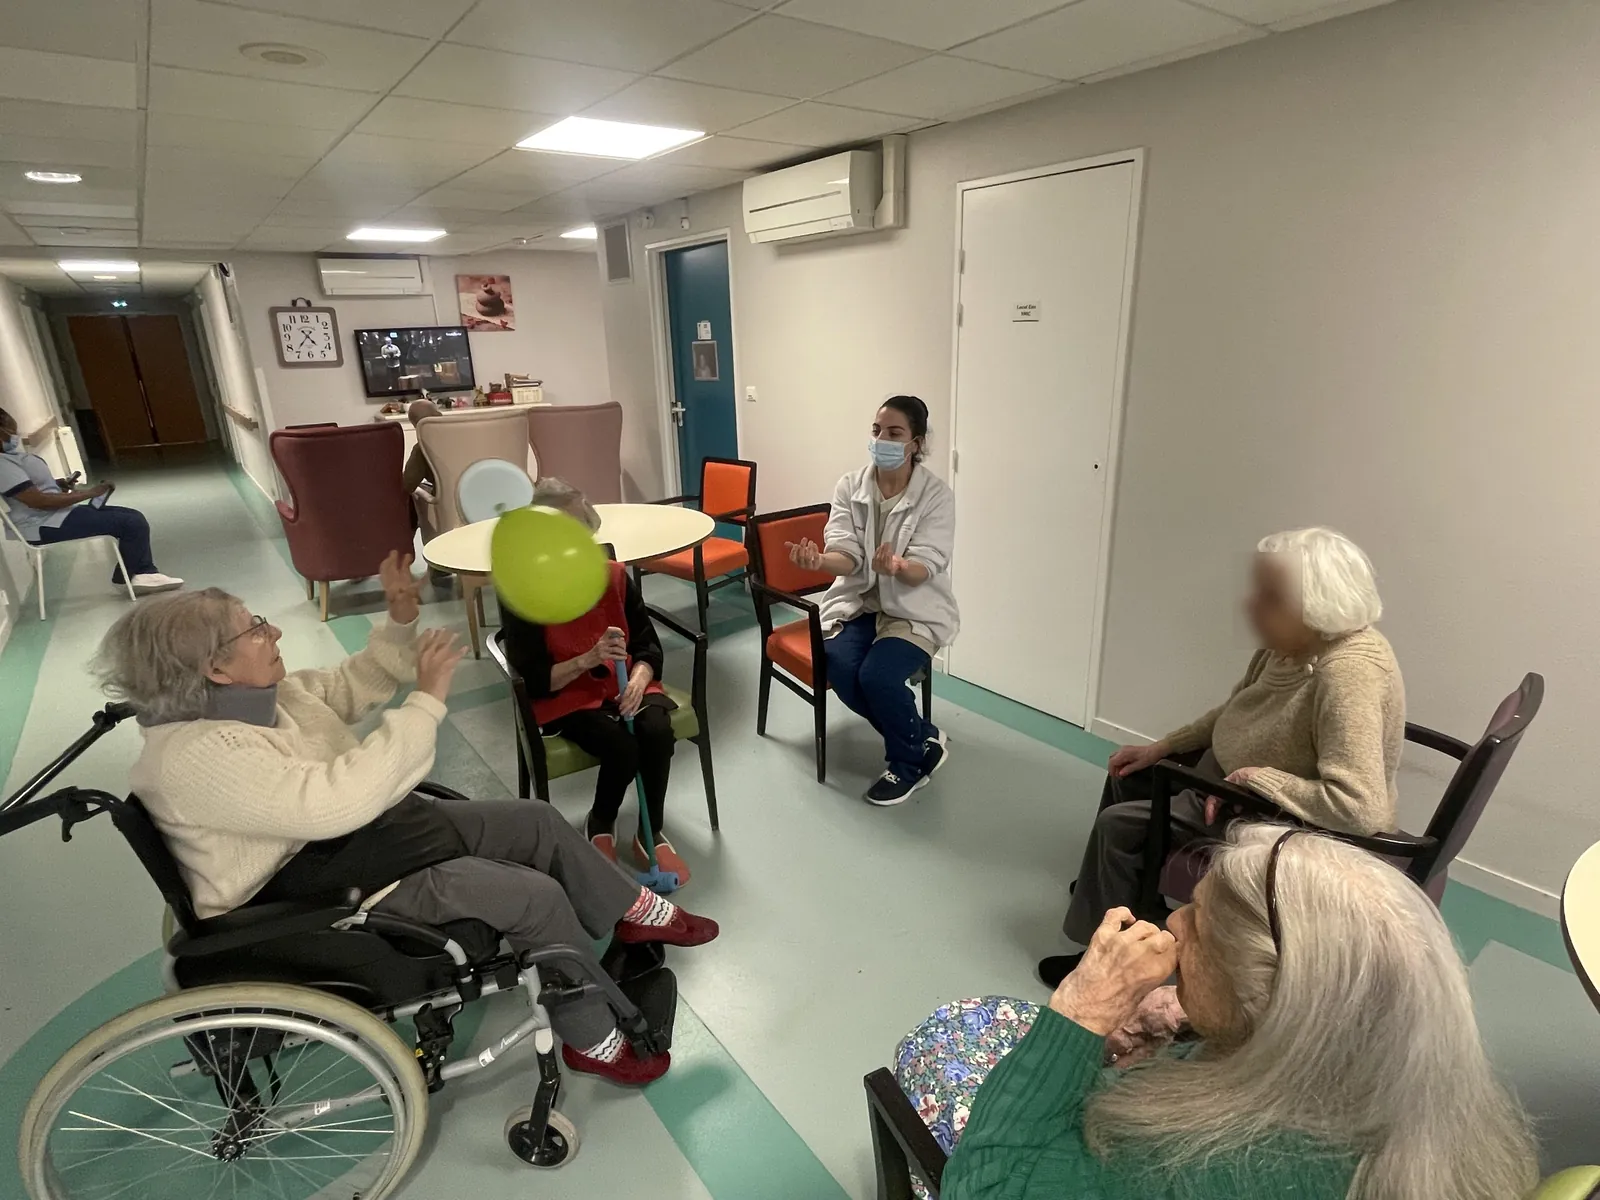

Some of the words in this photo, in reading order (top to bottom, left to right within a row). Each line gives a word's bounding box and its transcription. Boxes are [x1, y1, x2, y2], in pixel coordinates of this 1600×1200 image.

[289, 315, 296, 324] 11
[300, 314, 310, 324] 12
[316, 314, 319, 323] 1
[282, 324, 292, 332] 10
[322, 321, 328, 330] 2
[284, 333, 291, 341] 9
[324, 332, 330, 341] 3
[286, 344, 294, 352] 8
[296, 351, 301, 359] 7
[307, 351, 314, 359] 6
